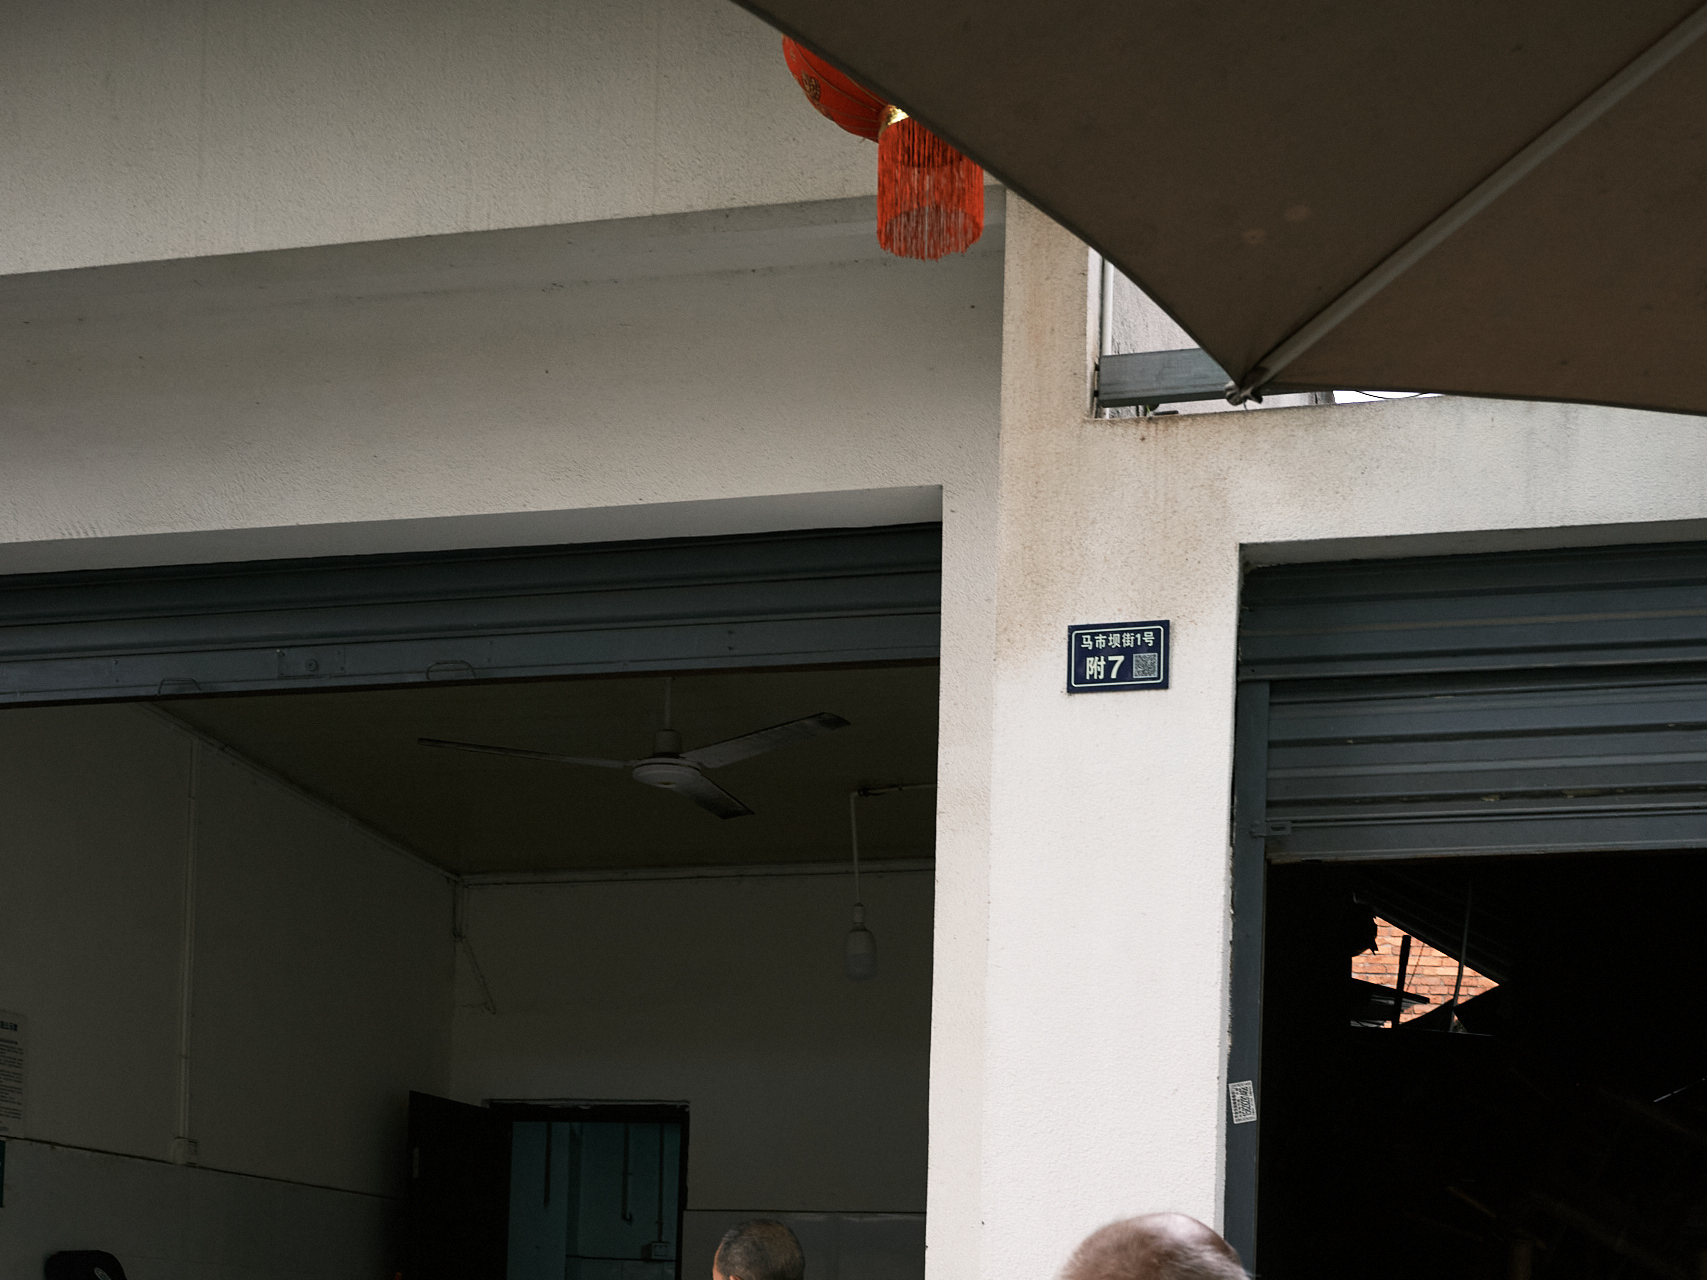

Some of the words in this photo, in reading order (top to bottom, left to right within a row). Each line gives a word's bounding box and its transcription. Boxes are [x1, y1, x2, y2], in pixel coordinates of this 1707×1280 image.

[1080, 631, 1155, 650] 马市坝街1号
[1086, 655, 1125, 680] 附7
